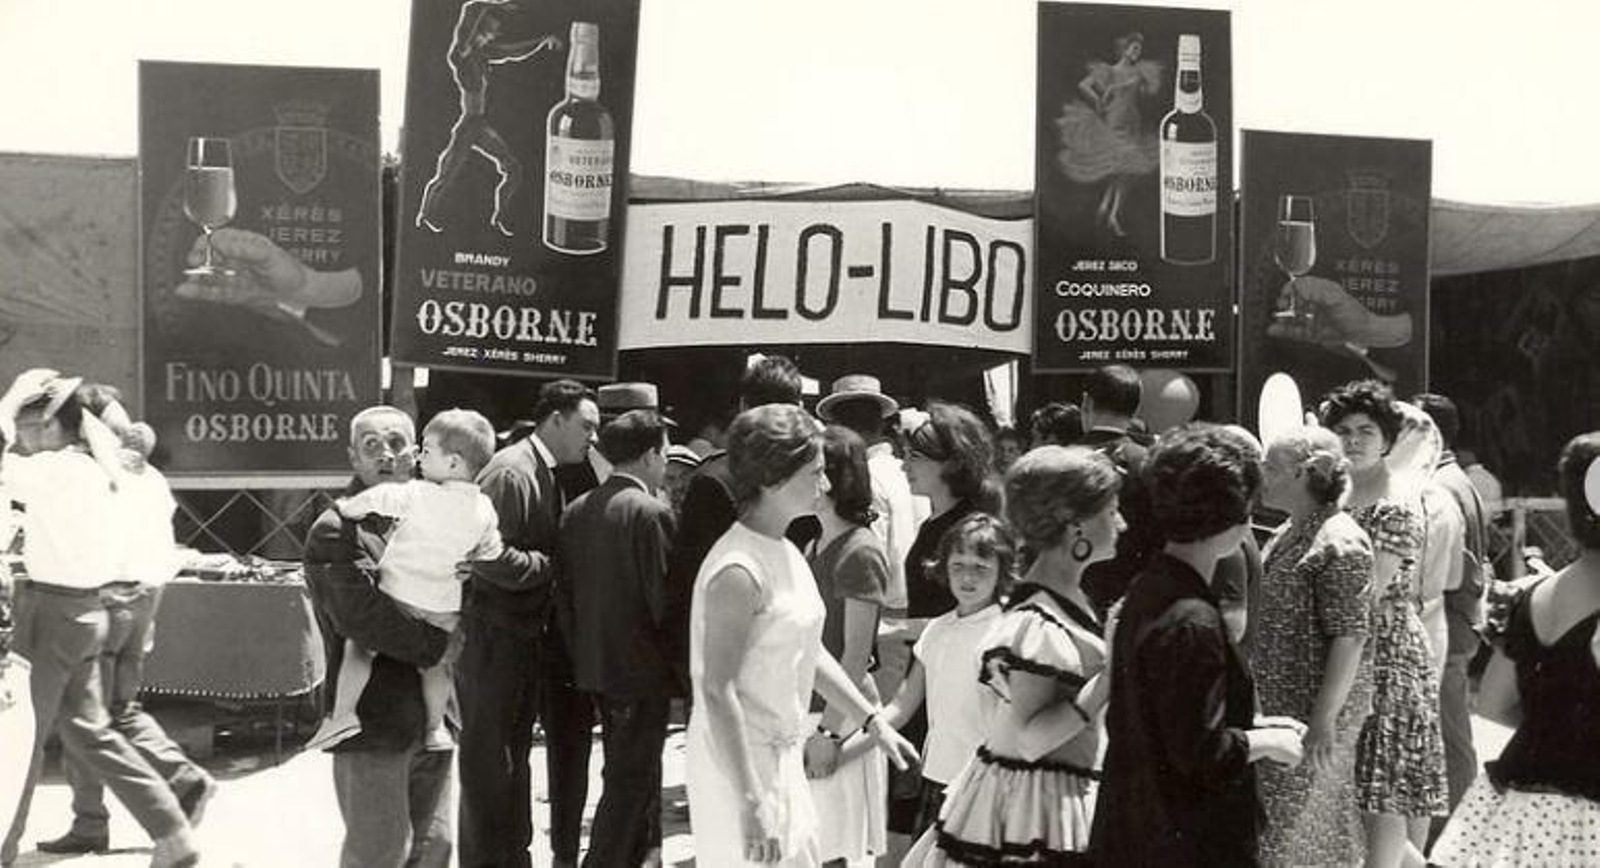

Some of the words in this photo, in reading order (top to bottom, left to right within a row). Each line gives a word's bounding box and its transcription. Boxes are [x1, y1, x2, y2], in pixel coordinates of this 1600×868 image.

[550, 172, 613, 188] OSBORNE
[454, 253, 510, 267] BRANDY
[421, 269, 536, 296] VETERANO
[655, 222, 1026, 332] HELO-LIBO
[416, 300, 598, 347] OSBORNE
[1055, 309, 1216, 342] OSBORNE
[523, 352, 567, 365] SHERRY
[165, 361, 240, 402] FINO
[248, 361, 356, 407] QUINTA
[186, 412, 339, 442] OSBORNE
